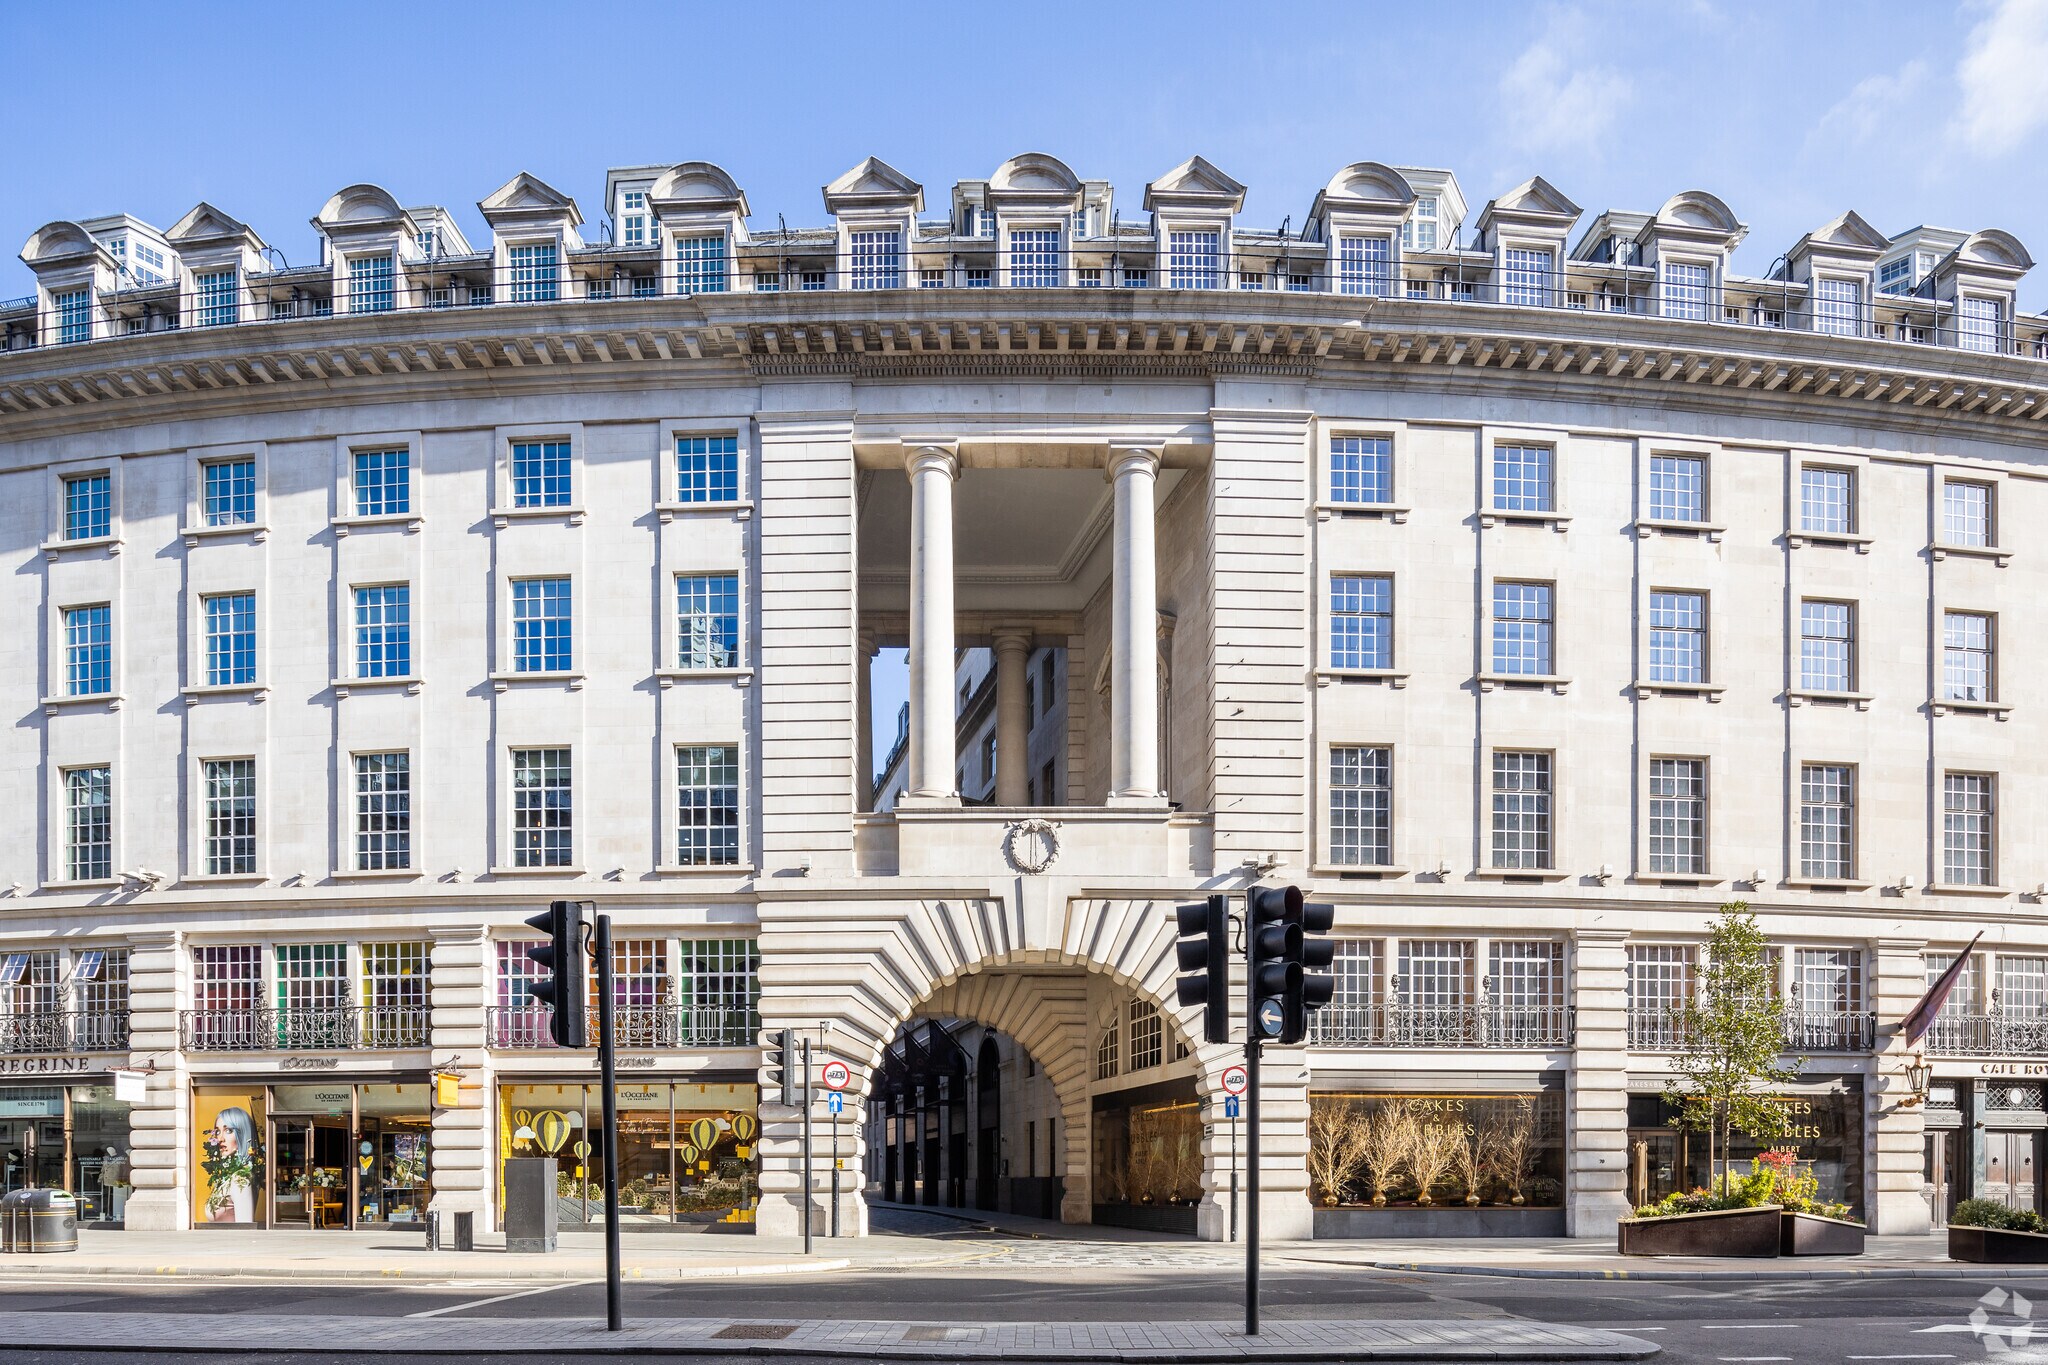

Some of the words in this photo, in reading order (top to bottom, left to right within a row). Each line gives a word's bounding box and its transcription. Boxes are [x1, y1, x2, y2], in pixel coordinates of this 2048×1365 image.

[1409, 1099, 1464, 1112] CAKES
[1433, 1113, 1440, 1122] &
[1770, 1145, 1801, 1153] ALBERT
